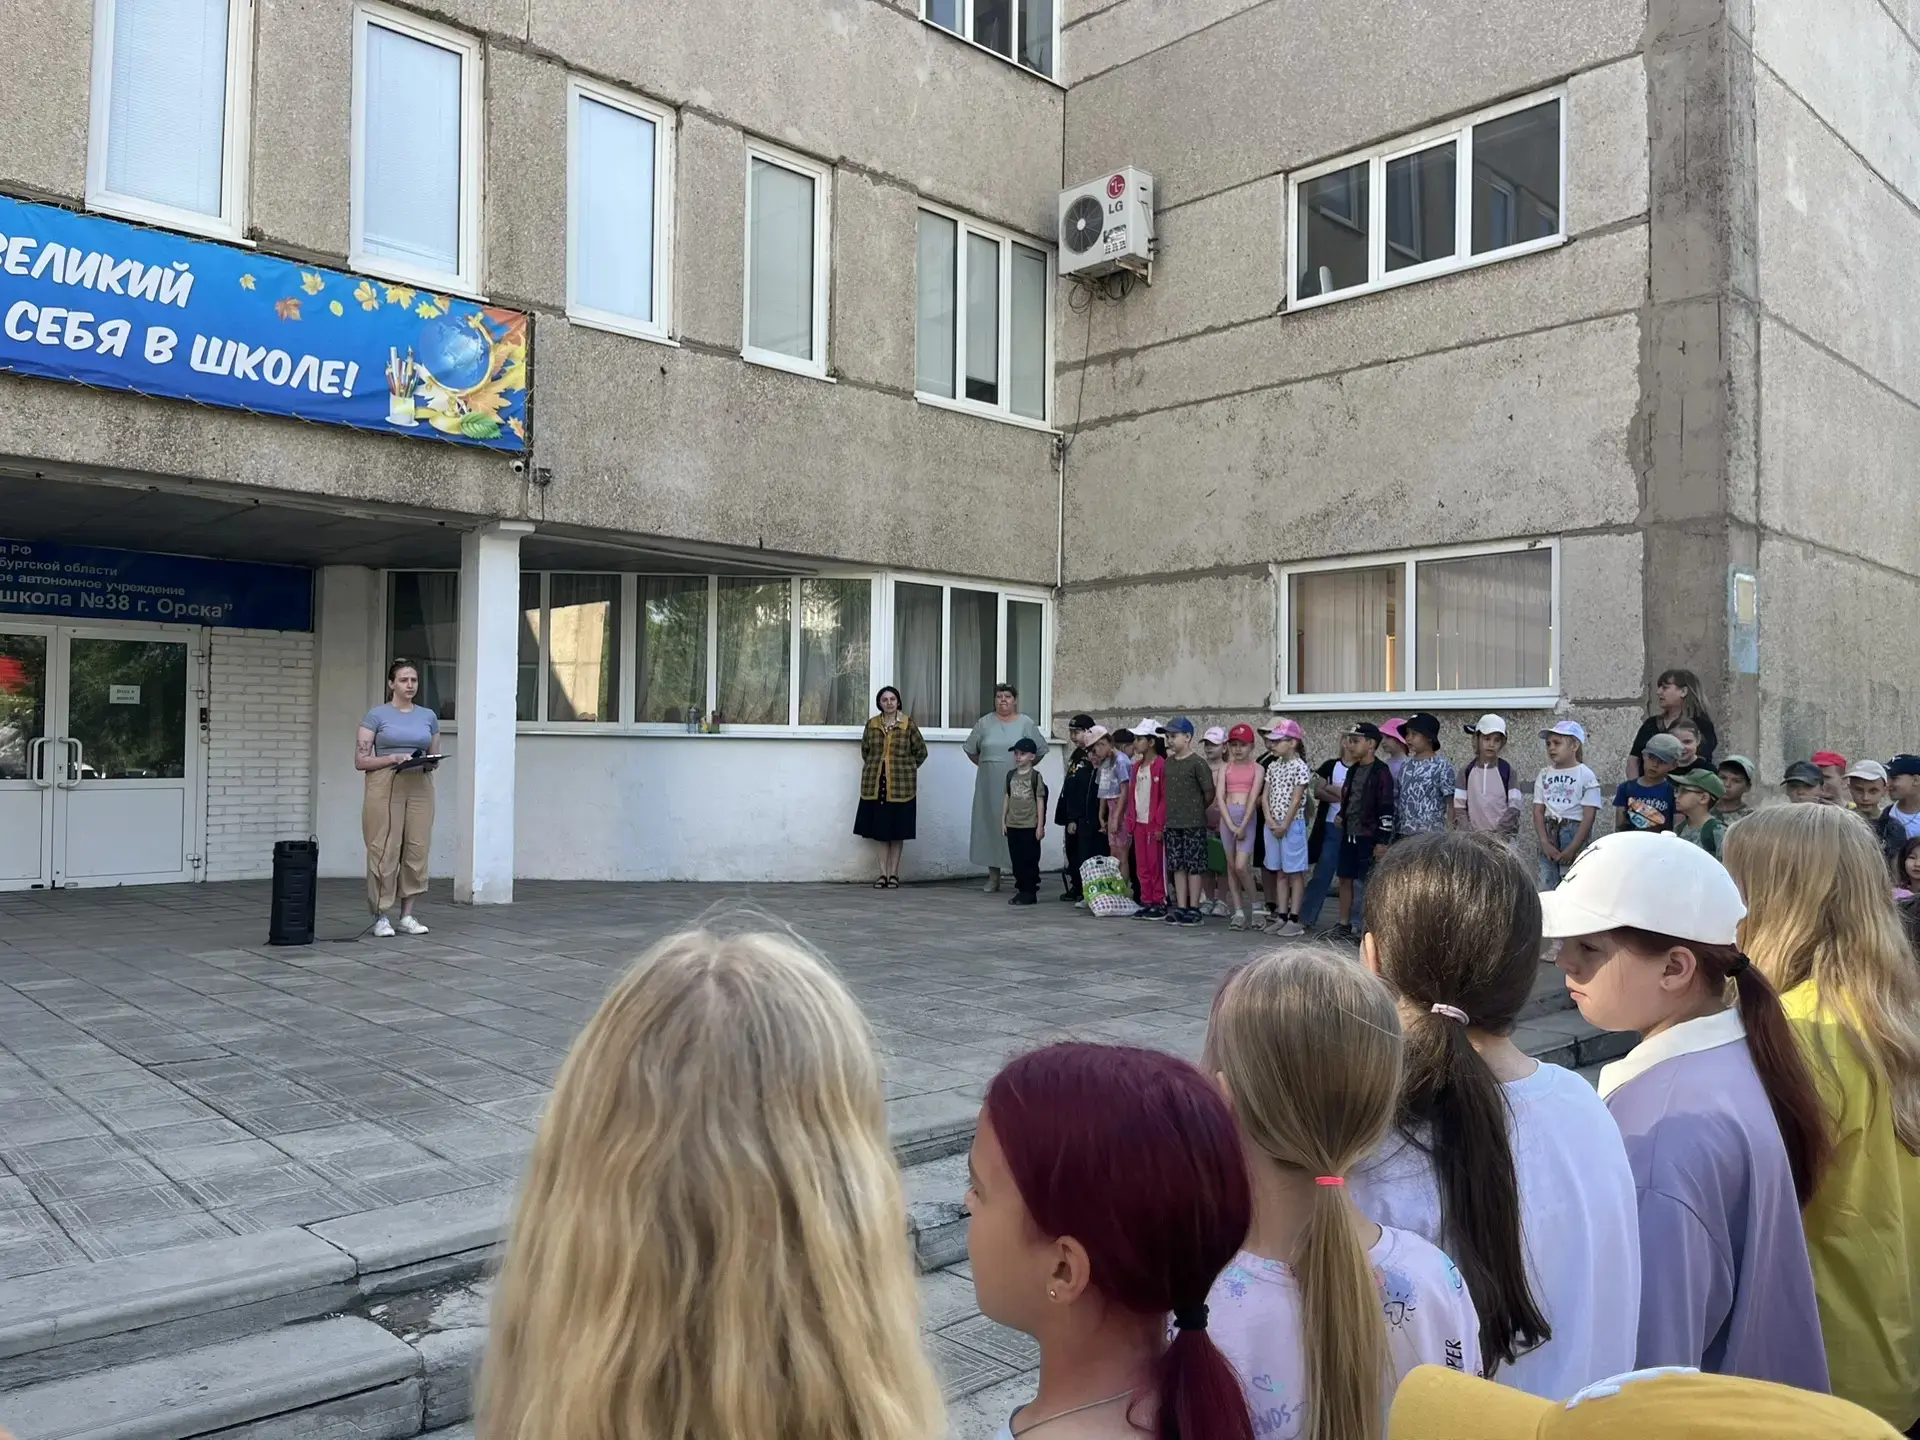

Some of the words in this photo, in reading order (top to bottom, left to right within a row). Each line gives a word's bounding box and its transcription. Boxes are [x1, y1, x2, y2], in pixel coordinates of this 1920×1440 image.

[1108, 200, 1123, 214] LG
[5, 301, 131, 357] СЕБЯ
[144, 327, 177, 364] В
[191, 334, 360, 398] ШКОЛЕ!
[11, 544, 32, 555] РФ
[64, 562, 118, 576] области
[18, 574, 102, 589] автономное
[106, 581, 186, 597] учреждение
[0, 589, 72, 607] школа
[80, 591, 130, 611] №38
[137, 599, 149, 612] г.
[1547, 775, 1577, 785] SALTY
[1445, 1339, 1464, 1372] PER
